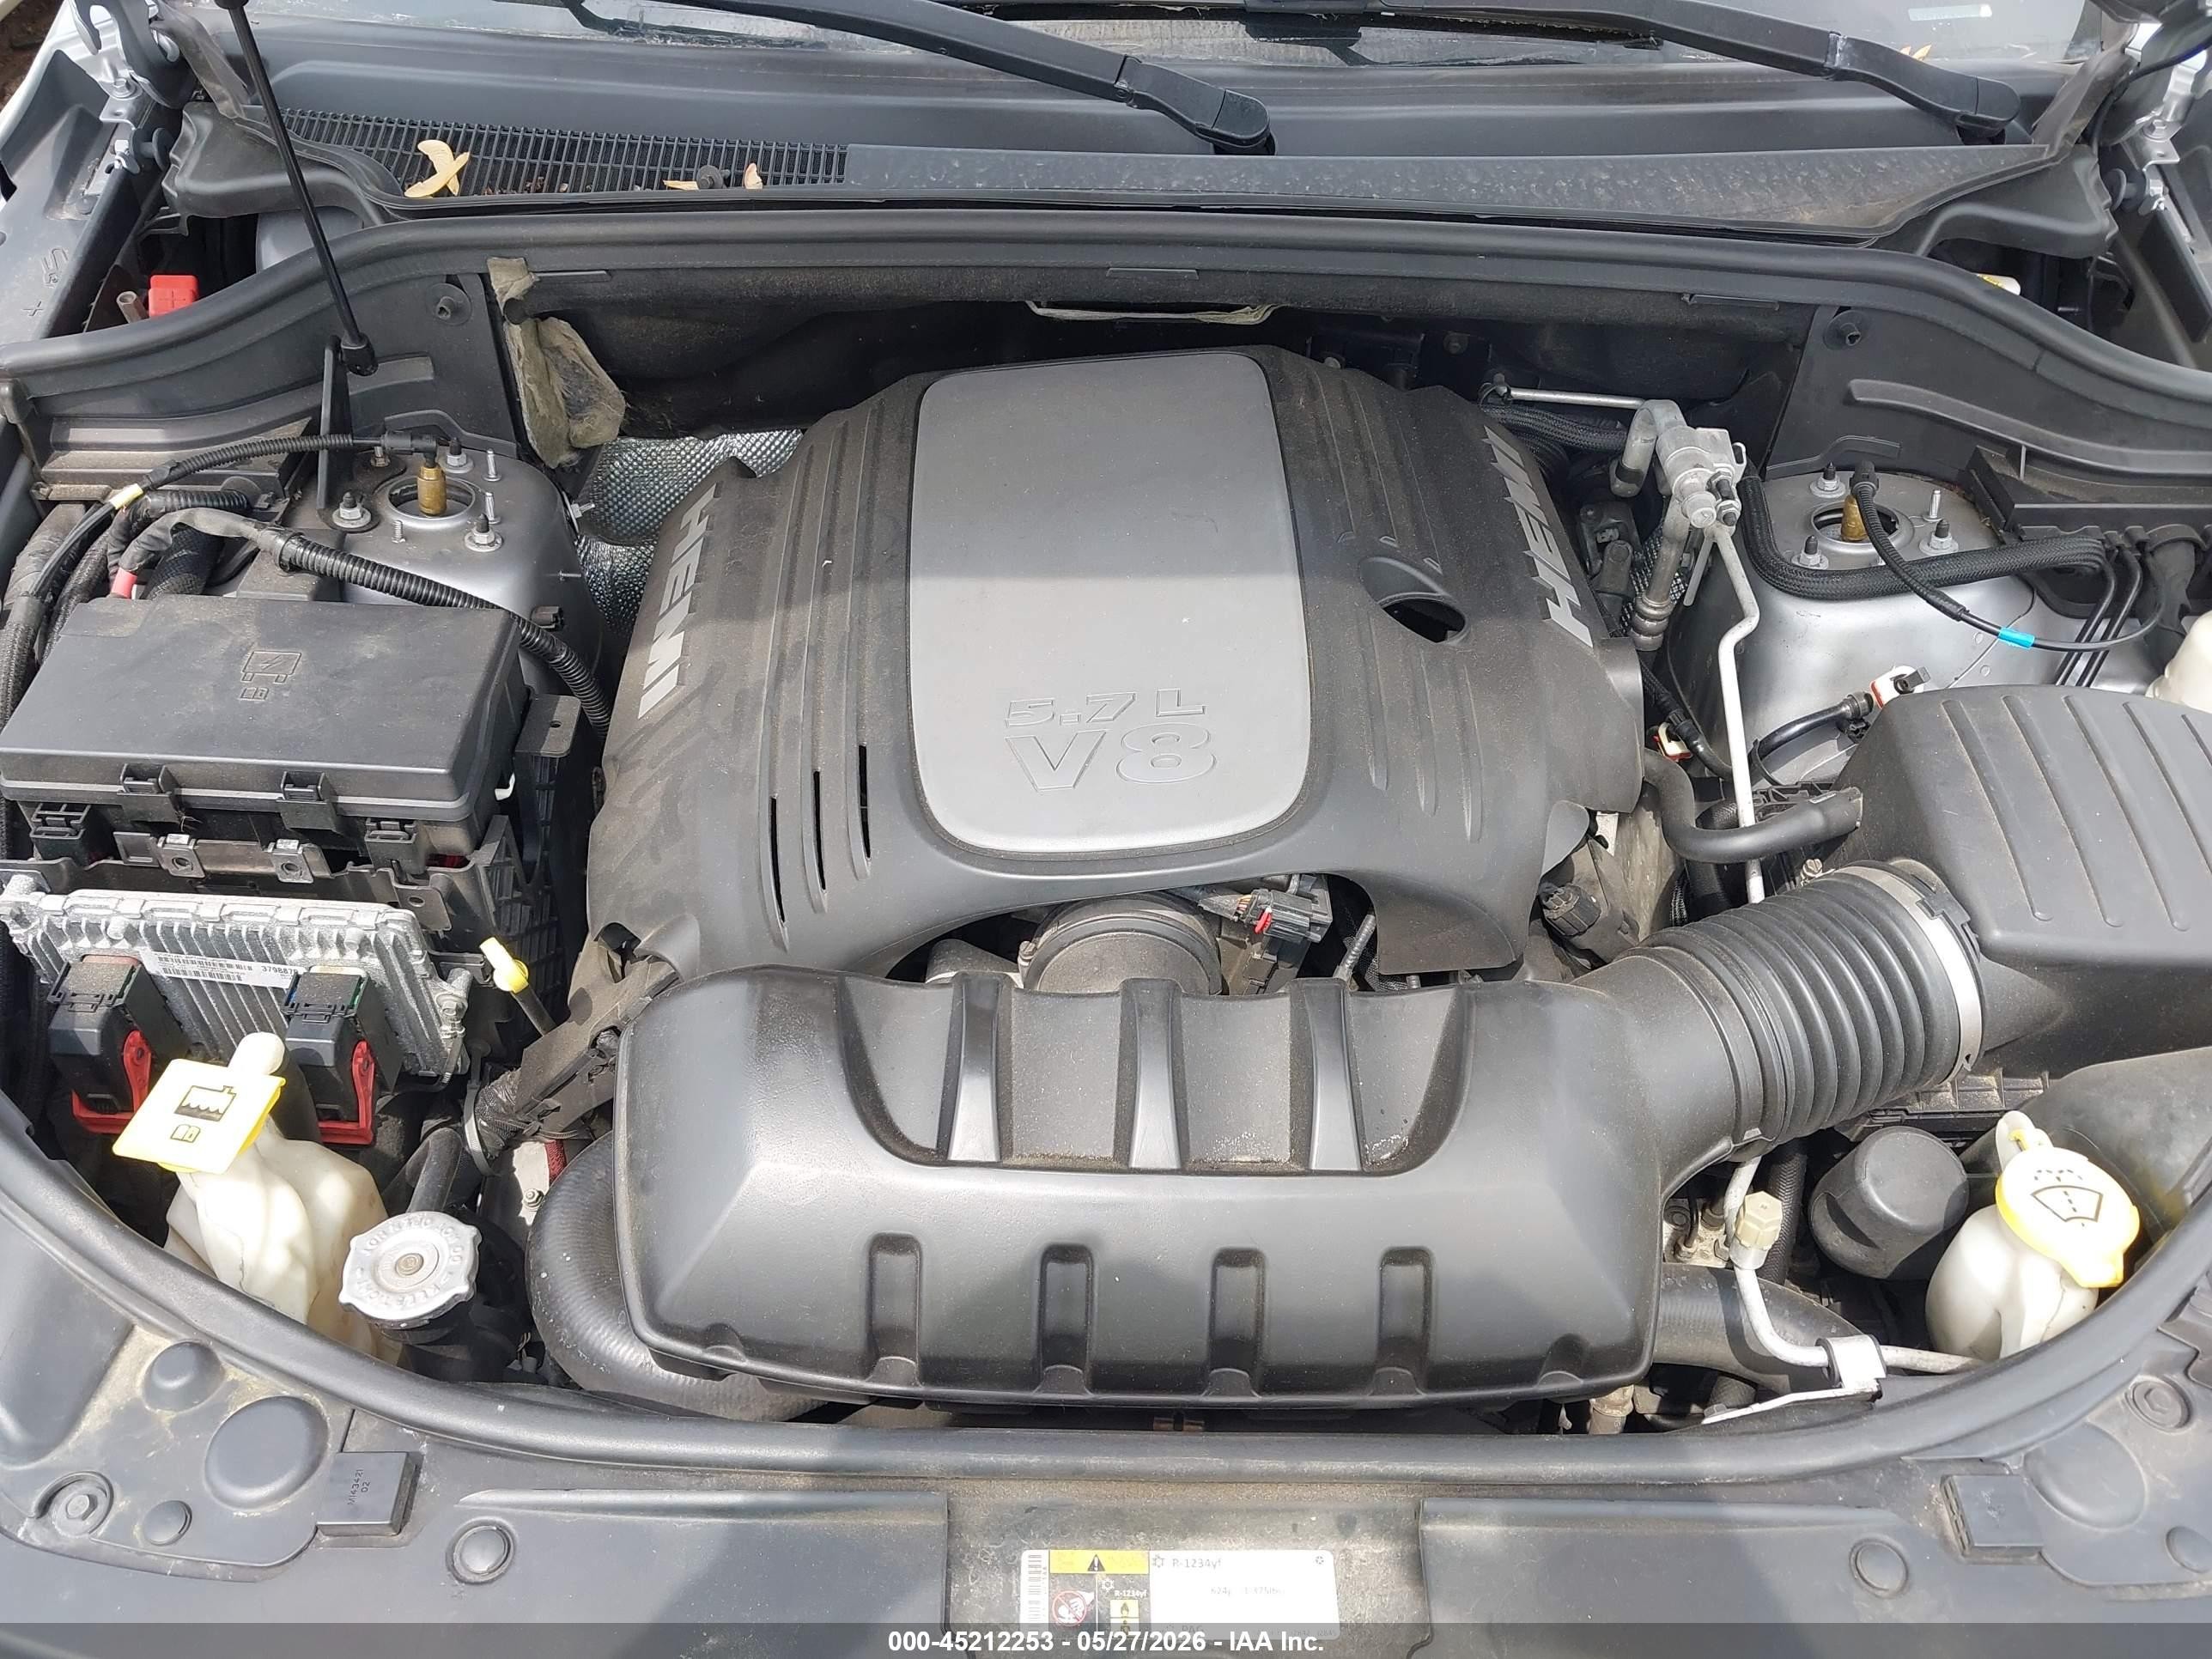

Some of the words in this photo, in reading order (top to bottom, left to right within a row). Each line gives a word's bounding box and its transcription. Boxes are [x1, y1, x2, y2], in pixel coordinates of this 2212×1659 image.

[1483, 425, 1594, 649] HEMI
[638, 483, 718, 720] HEMI
[1004, 722, 1218, 793] V8
[1115, 1589, 1147, 1599] R-1234yf
[1172, 1558, 1223, 1570] R-1234yf
